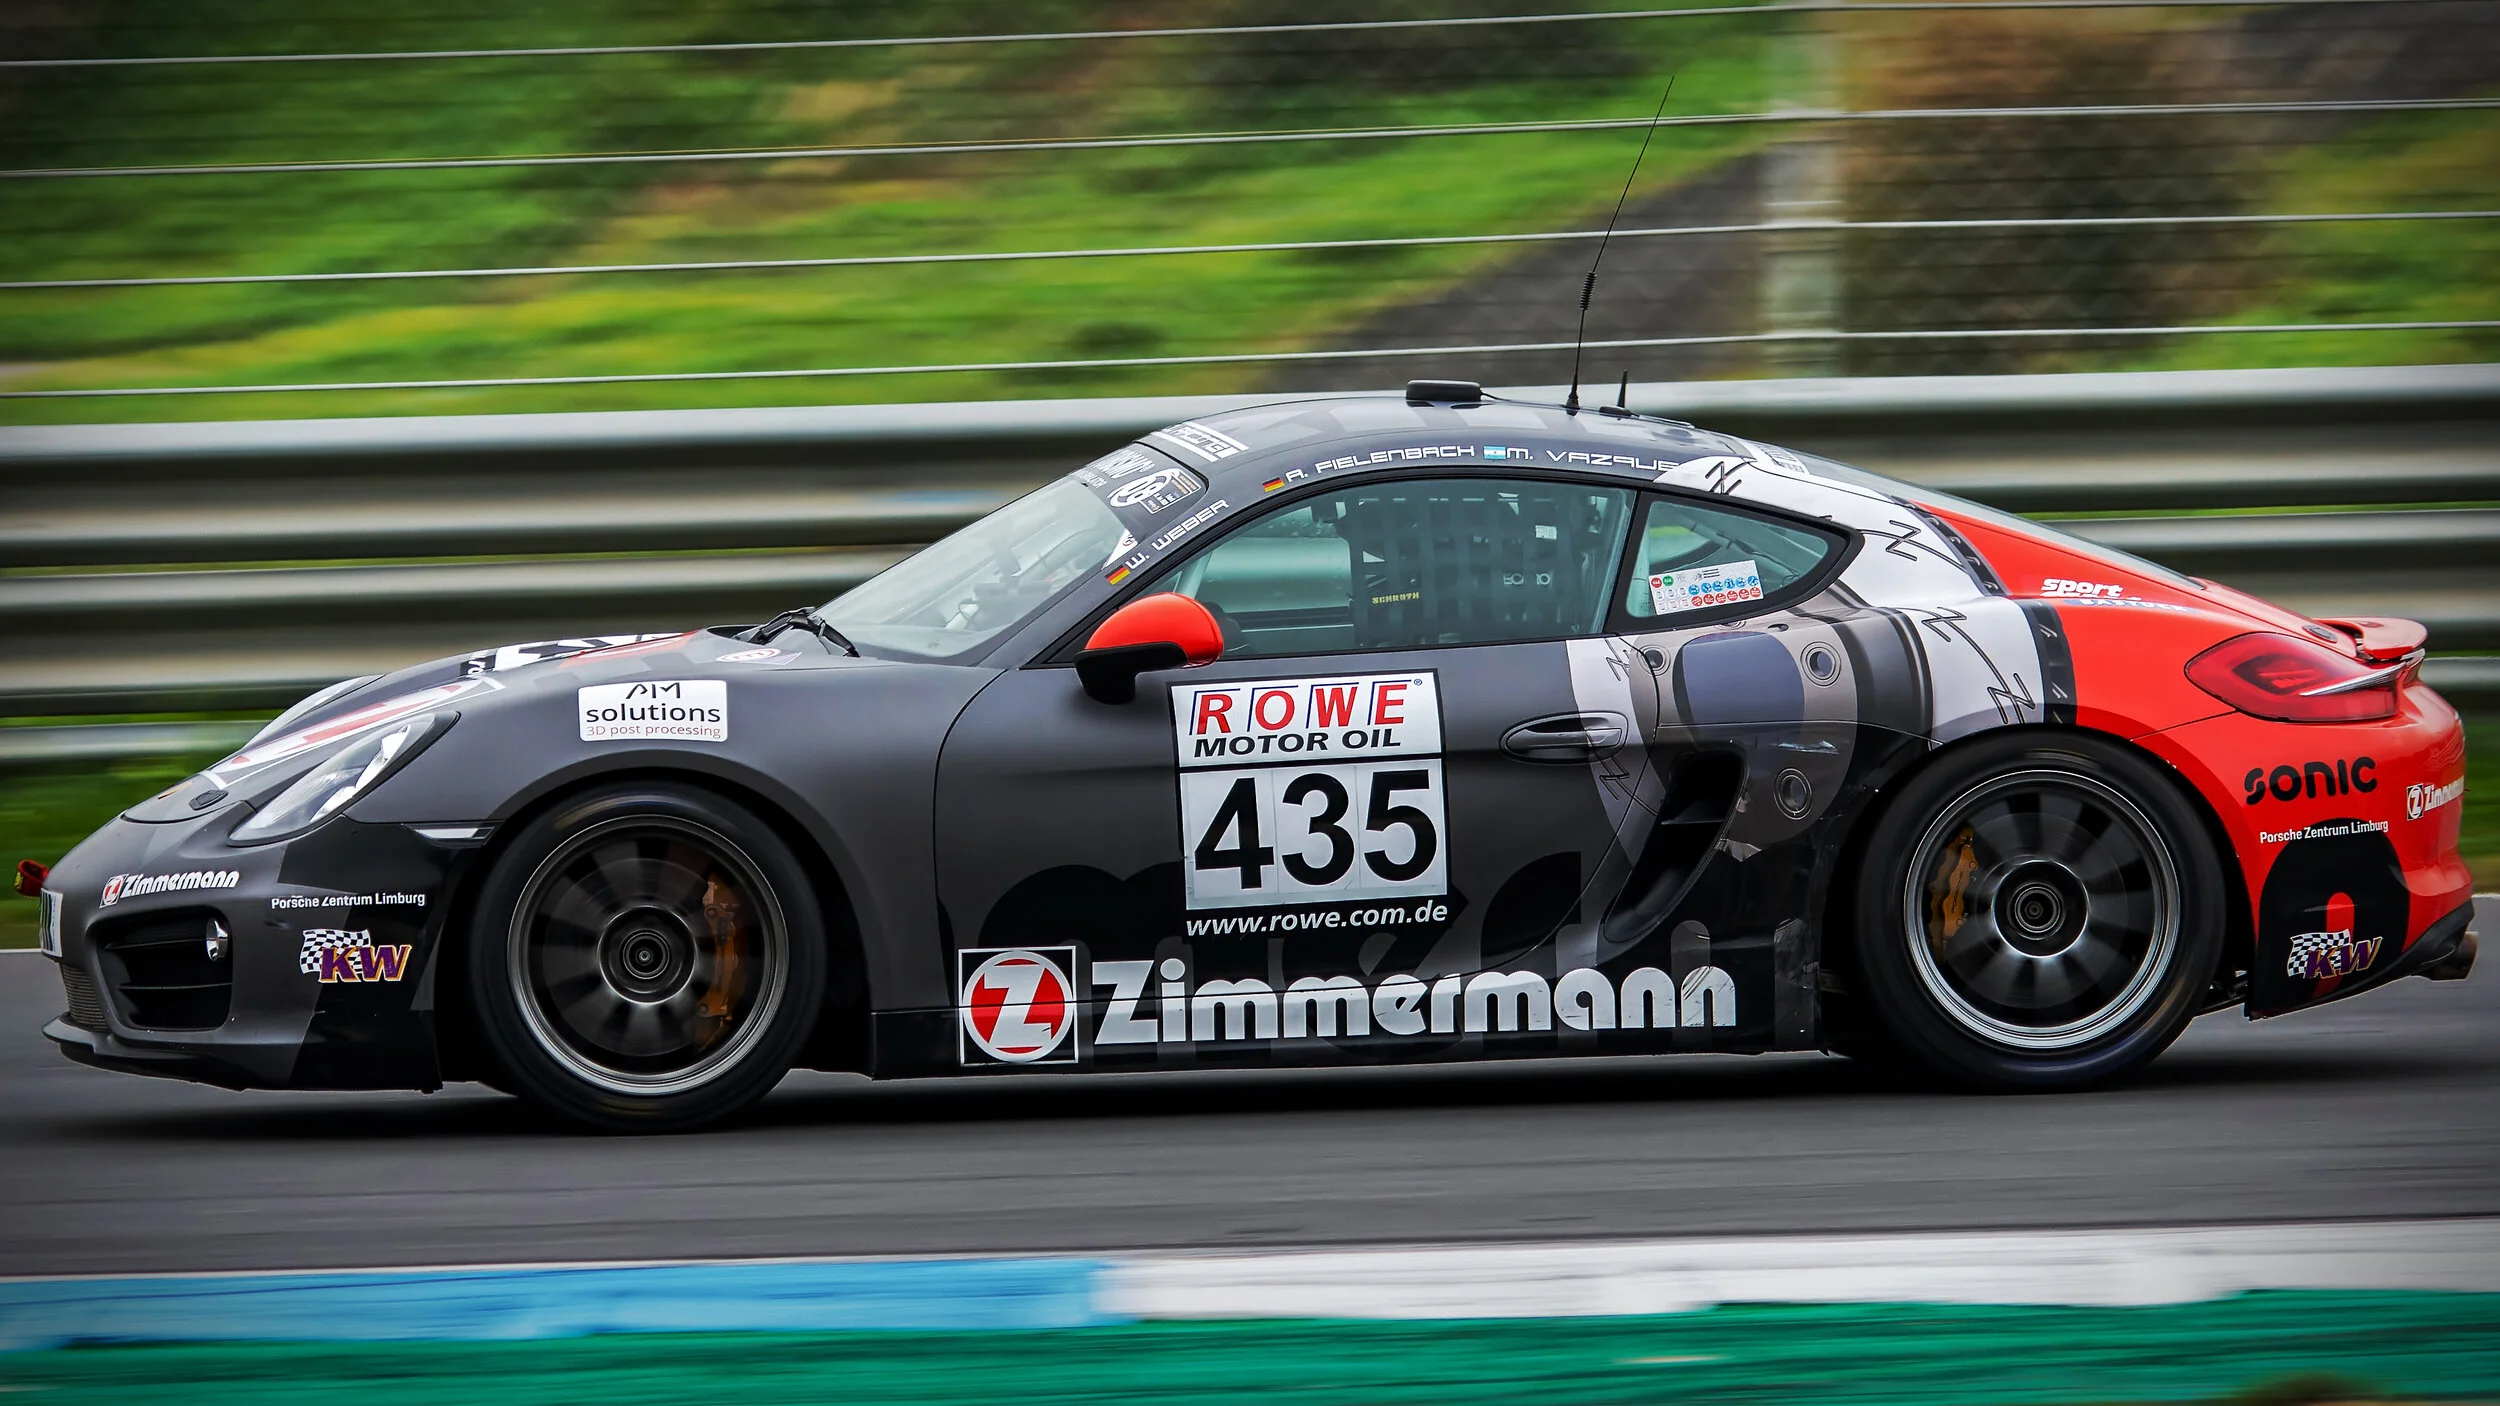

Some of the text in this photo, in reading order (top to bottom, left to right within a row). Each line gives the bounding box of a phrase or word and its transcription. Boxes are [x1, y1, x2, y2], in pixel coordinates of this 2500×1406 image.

[1125, 499, 1230, 570] W. WEBER
[2040, 578, 2123, 597] sport
[586, 703, 721, 723] solutions
[587, 724, 721, 739] 3D post processing
[1194, 728, 1401, 758] MOTOR OIL
[1194, 768, 1438, 890] 435
[2260, 820, 2389, 844] Porsche Zentrum Limburg
[120, 870, 240, 899] Zimmermann
[271, 895, 319, 910] Porsche
[375, 892, 426, 907] Limburg
[1186, 899, 1448, 937] www.rowe.com.de
[318, 944, 413, 984] KW
[2303, 935, 2384, 980] KW
[1092, 958, 1737, 1046] Zimmermann
